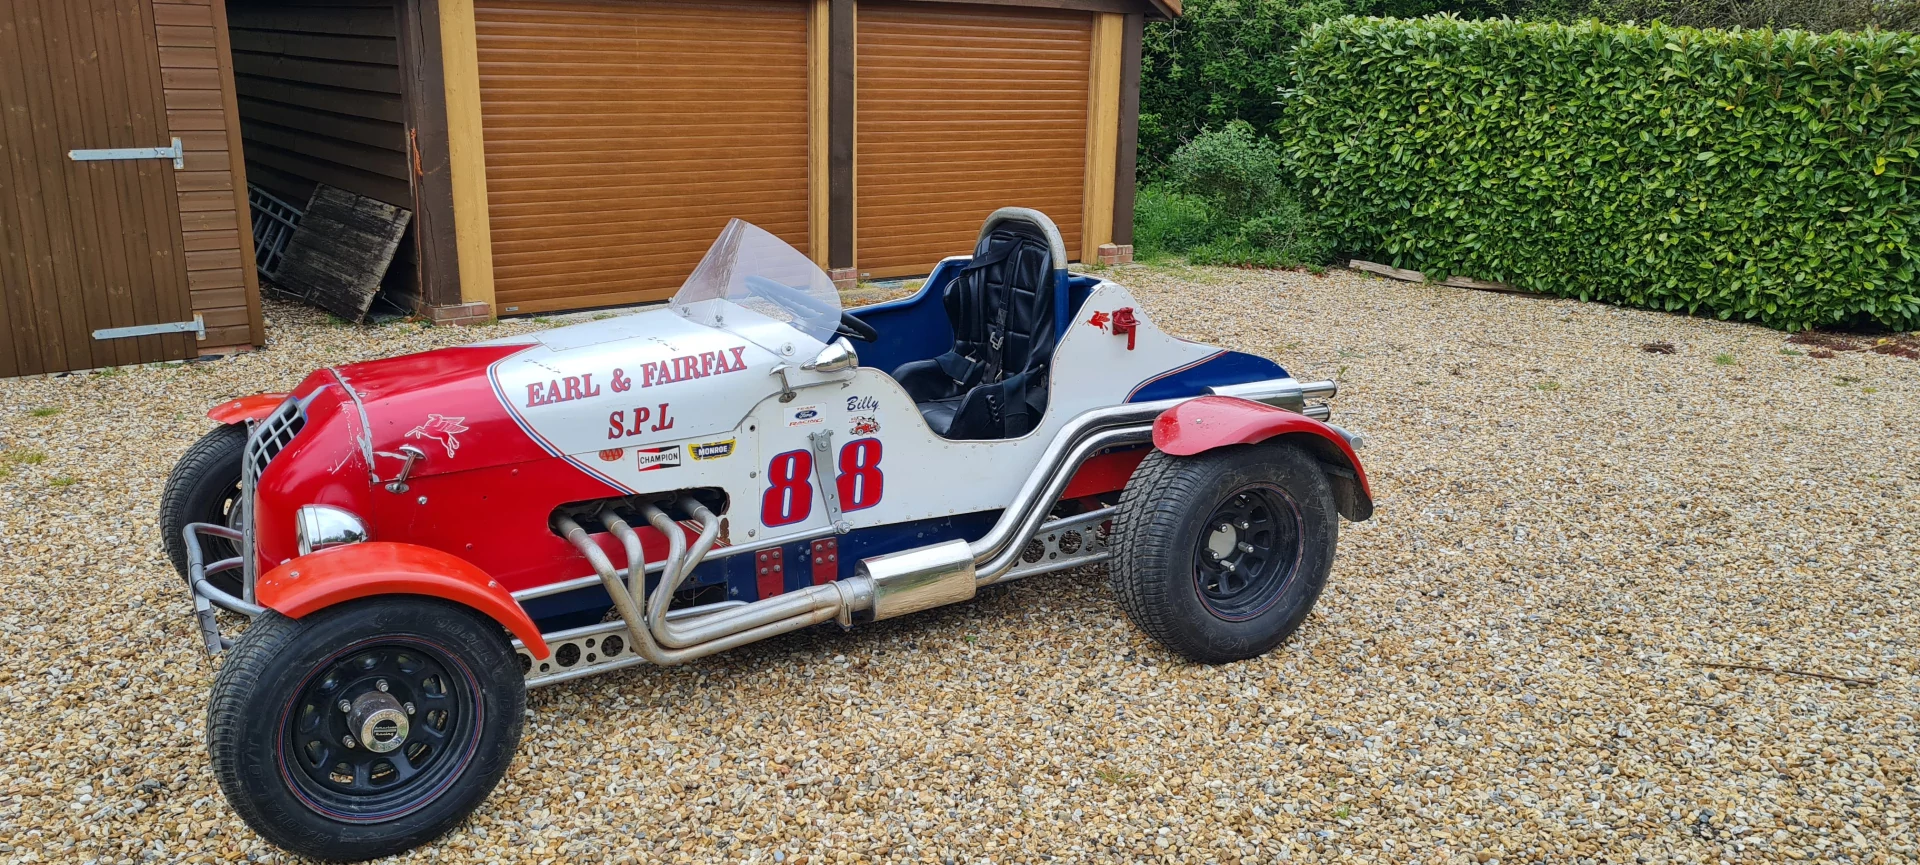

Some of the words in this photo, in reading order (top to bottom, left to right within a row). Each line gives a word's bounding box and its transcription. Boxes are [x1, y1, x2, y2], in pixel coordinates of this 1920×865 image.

[526, 373, 600, 408] EARL
[610, 368, 632, 393] &
[640, 346, 748, 388] FAIRFAX
[847, 396, 880, 412] Billy
[789, 418, 824, 426] RACING
[600, 447, 620, 460] AAA
[698, 444, 729, 456] MONROE
[639, 452, 679, 465] CHAMPION
